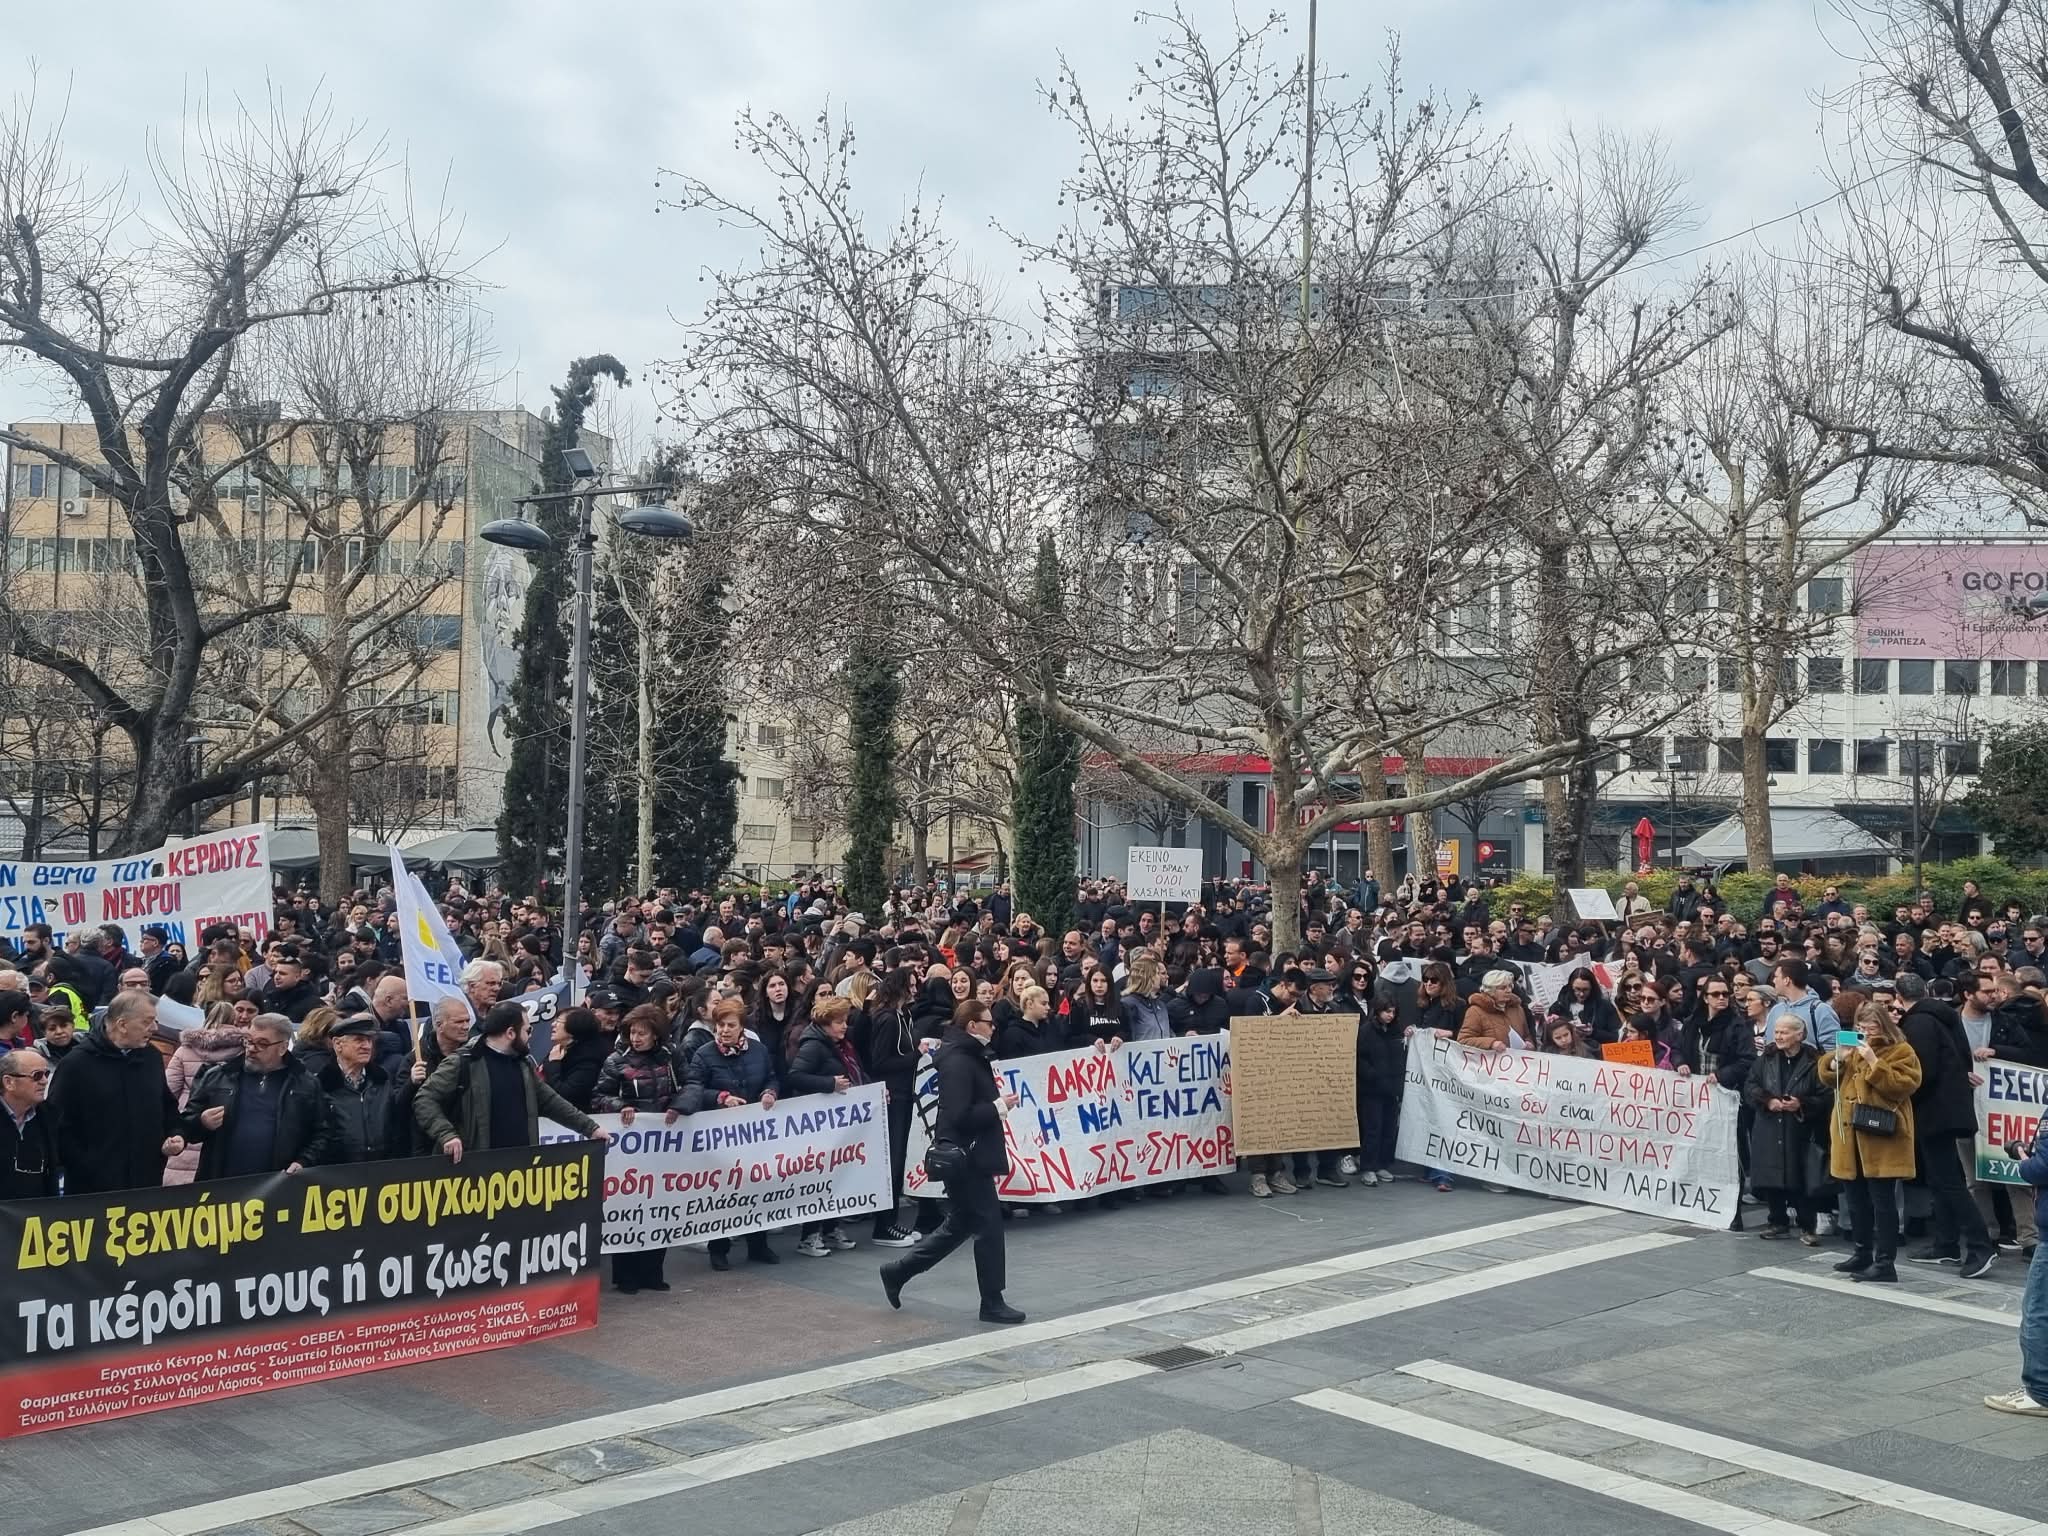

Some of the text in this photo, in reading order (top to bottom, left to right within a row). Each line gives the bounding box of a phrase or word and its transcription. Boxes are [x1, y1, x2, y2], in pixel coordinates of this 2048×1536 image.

[1963, 572, 2048, 591] GO FO
[1867, 628, 1904, 637] ΕΘΝΙΚΗ
[1881, 637, 1926, 646] ΤΡΑΠΕΖΑ
[112, 858, 153, 882] ΤΟΥ
[168, 834, 262, 877] ΚΕΡΔΟΥΣ
[1130, 850, 1170, 863] ΕΚΕΙΝΟ
[1146, 864, 1189, 873] ΤΟ ΒΡΑΔΥ
[1155, 874, 1182, 886] ΟΛΟΙ
[0, 882, 182, 930] ΣΙΑ ΟΙ ΝΕΚΡΟΙ
[1132, 887, 1200, 899] ΧΑΣΑΜΕ ΚΑΤΙ
[1047, 1054, 1116, 1104] ΔΑΚΡΥΑ
[1128, 1050, 1166, 1086] ΚΑΙ
[1432, 1037, 1451, 1065] Η
[1555, 1079, 1573, 1092] και
[1593, 1067, 1711, 1111] ΑΣΦΑΛΕΙΑ
[691, 1117, 779, 1154] ΕΙΡΗΝΗΣ
[784, 1101, 873, 1138] ΛΑΡΙΣΑΣ
[1037, 1107, 1061, 1146] Η
[1078, 1099, 1123, 1135] ΝΕΑ
[1137, 1086, 1222, 1121] ΓΕΝΙΑ
[1484, 1095, 1510, 1110] μας
[1520, 1093, 1548, 1115] δεν
[1609, 1102, 1697, 1139] ΚΟΣΤΟΣ
[603, 1140, 867, 1201] ρδη τους ή οι ζωές μας
[998, 1146, 1076, 1197] ΔΕΝ
[1089, 1139, 1136, 1184] ΣΑΣ
[1514, 1153, 1608, 1192] ΓΟΝΕΩΝ
[1623, 1171, 1722, 1215] ΛΑΡΙΣΑΣ
[18, 1216, 95, 1270] Δεν
[105, 1192, 265, 1267] ξεχνάμε
[301, 1185, 368, 1233] Δεν
[377, 1154, 590, 1227] συγχωρούμε!
[649, 1204, 681, 1221] της
[686, 1189, 760, 1216] Ελλάδας
[762, 1182, 796, 1204] από
[799, 1178, 834, 1200] τους
[650, 1208, 763, 1245] σχεδιασμούς
[766, 1205, 794, 1223] και
[796, 1192, 878, 1217] πολέμους
[19, 1222, 588, 1353] Τα κέρδη τους ή οι ζωές μας!
[19, 1381, 130, 1411] Φαρμακευτικός
[133, 1369, 200, 1392] Σύλλογος
[202, 1359, 258, 1379] Λάρισας
[268, 1347, 328, 1367] Σωματείο
[331, 1335, 396, 1357] Ιδιοκτητών
[400, 1330, 427, 1345] ΤΑΞΙ
[428, 1323, 478, 1340] Λάρισας
[486, 1313, 530, 1330] ΣΙΚΑΕΛ
[100, 1360, 163, 1382] Εργατικό
[166, 1351, 214, 1369] Κέντρο
[217, 1347, 231, 1361] Ν.
[234, 1339, 289, 1359] Λάρισας
[300, 1329, 345, 1347] ΟΕΒΕΛ
[356, 1318, 421, 1338] Εμπορικός
[422, 1307, 477, 1326] Σύλλογος
[478, 1300, 525, 1317] Λάρισας
[19, 1410, 65, 1428] Ένωση
[68, 1397, 129, 1420] Συλλόγων
[131, 1389, 176, 1407] Γονέων
[177, 1382, 215, 1400] Δήμου
[216, 1374, 264, 1392] Λάρισας
[272, 1363, 327, 1383] Φοιτητικοί
[329, 1354, 376, 1373] Σύλλογοι
[383, 1345, 432, 1362] Σύλλογος
[433, 1336, 480, 1352] Συγγενών
[482, 1328, 525, 1344] Θυμάτων
[559, 1314, 578, 1328] 2023
